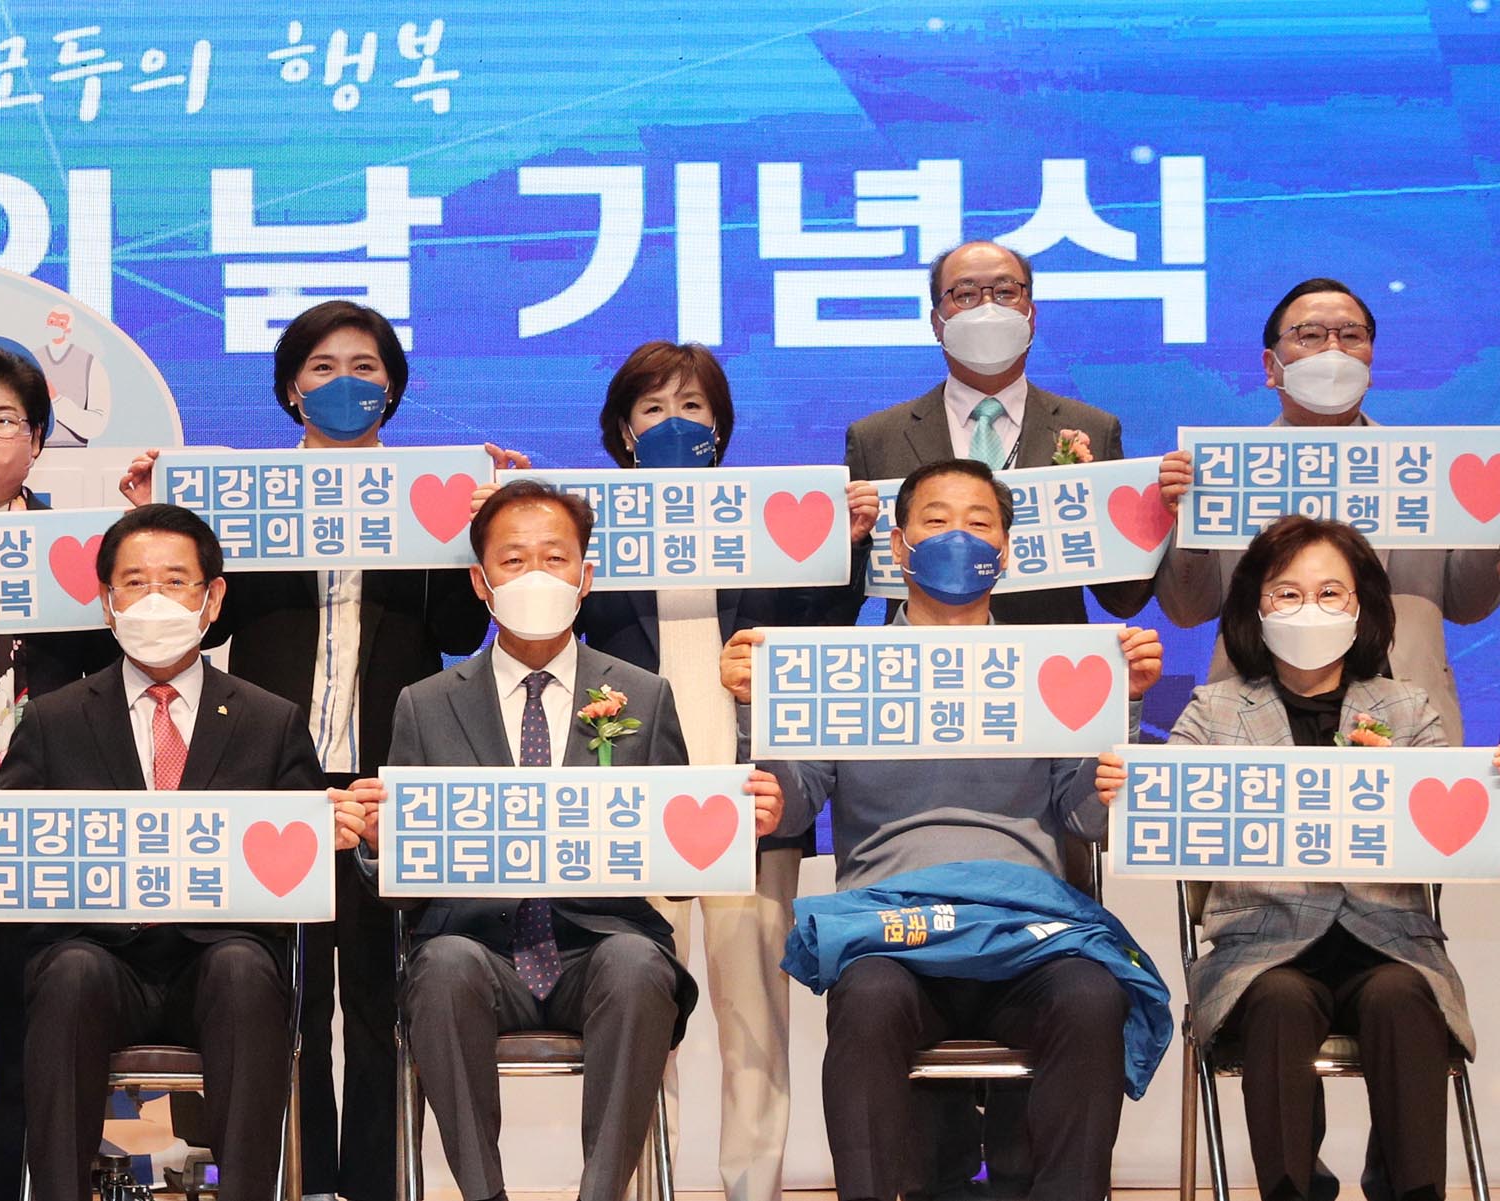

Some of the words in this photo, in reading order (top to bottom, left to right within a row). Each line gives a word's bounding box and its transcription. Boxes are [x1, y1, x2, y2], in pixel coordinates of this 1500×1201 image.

[267, 18, 461, 113] 행복
[211, 165, 443, 354] 날
[518, 155, 1207, 348] 기념식
[172, 468, 300, 508] 건강한
[312, 467, 393, 506] 일상
[1200, 446, 1335, 486] 건강한
[1347, 446, 1432, 485] 일상
[662, 485, 746, 524] 일상
[1011, 482, 1089, 526] 일상
[1347, 495, 1430, 533] 행복
[219, 517, 299, 557] 두의
[313, 516, 392, 555] 행복
[664, 534, 746, 575] 행복
[1012, 531, 1095, 574] 행복
[775, 647, 917, 691] 건강한
[930, 647, 1020, 689] 일상
[775, 701, 915, 744] 모두의
[930, 701, 1017, 743] 행복
[402, 785, 543, 829] 건강한
[556, 786, 645, 827] 일상
[1134, 765, 1282, 811] 건강한
[1295, 768, 1389, 812] 일상
[136, 812, 224, 854] 일상
[1132, 822, 1278, 865] 모두의
[1295, 822, 1387, 866] 행복
[401, 839, 540, 882] 모두의
[556, 839, 644, 881] 행복
[136, 865, 223, 908] 행복
